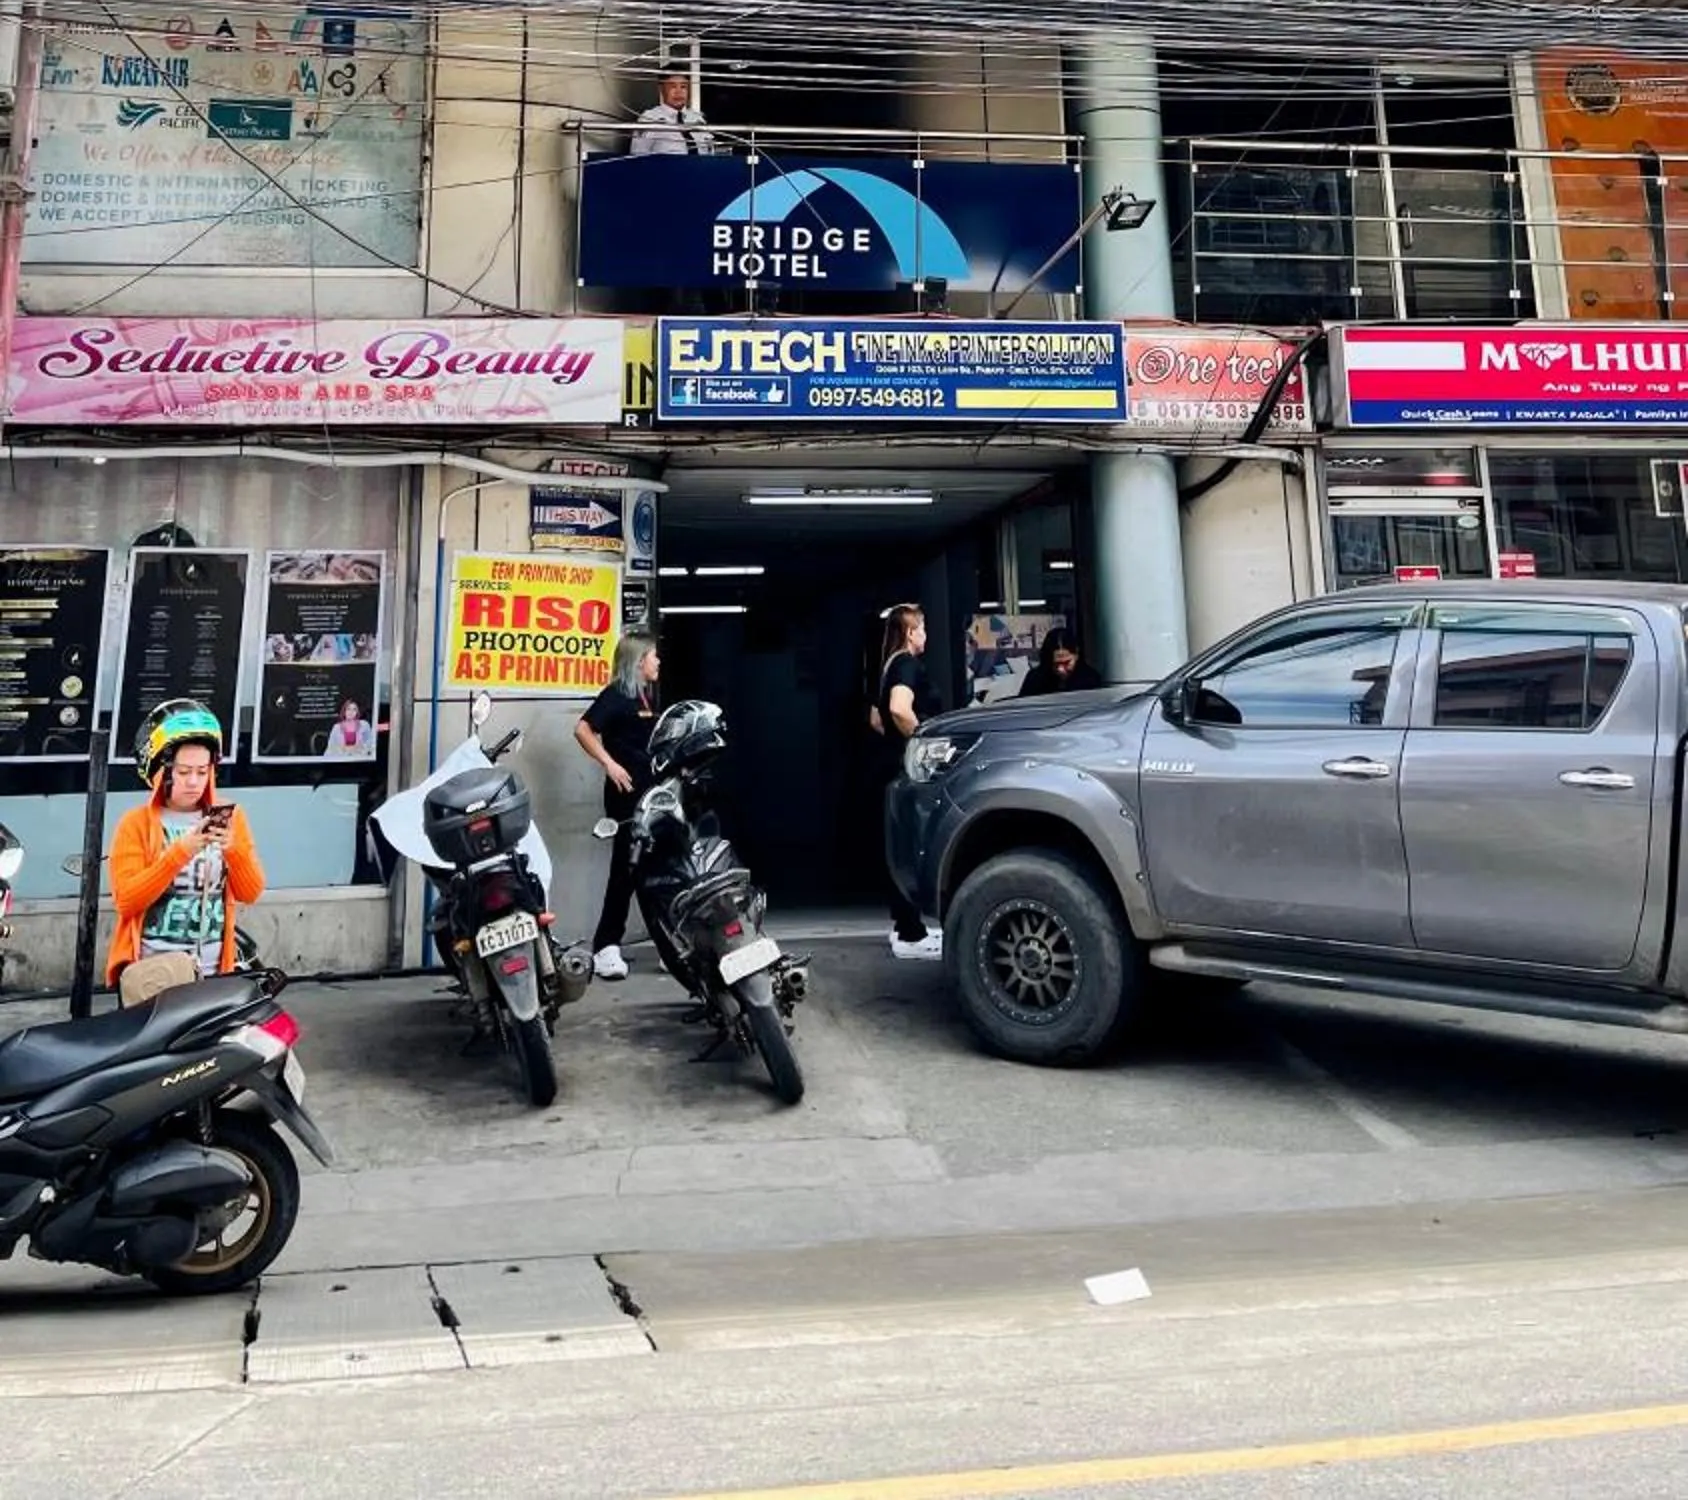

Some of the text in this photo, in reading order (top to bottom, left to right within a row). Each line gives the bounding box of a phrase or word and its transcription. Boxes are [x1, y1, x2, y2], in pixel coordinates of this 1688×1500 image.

[43, 173, 133, 188] DOMESTIC
[156, 175, 294, 191] INTERNATIONAL
[300, 178, 389, 192] TICKETING
[41, 190, 132, 205] DOMESTIC
[155, 192, 290, 208] INTERNATIONAL
[39, 207, 66, 222] WE
[71, 208, 142, 222] ACCEPT
[713, 225, 871, 252] BRIDGE
[713, 254, 828, 279] HOTEL
[38, 328, 596, 385] Seductive Beauty
[669, 328, 1113, 373] EJTECH FINE INK & PRINTER SOLUTION
[1136, 345, 1218, 385] One
[204, 383, 436, 402] SALON AND SPA
[705, 388, 758, 400] facebook
[1542, 381, 1582, 393] Ang
[1588, 381, 1639, 393] Tulay
[1646, 383, 1671, 393] ng
[808, 387, 945, 408] 0997-549-6812
[1401, 409, 1435, 419] Quick
[1515, 410, 1567, 419] KWARTA
[580, 509, 606, 523] WAY
[517, 563, 567, 583] PRINTING
[462, 591, 611, 635] RISO
[464, 631, 605, 657] PHOTOCOPY
[455, 652, 610, 687] A3 PRINTING
